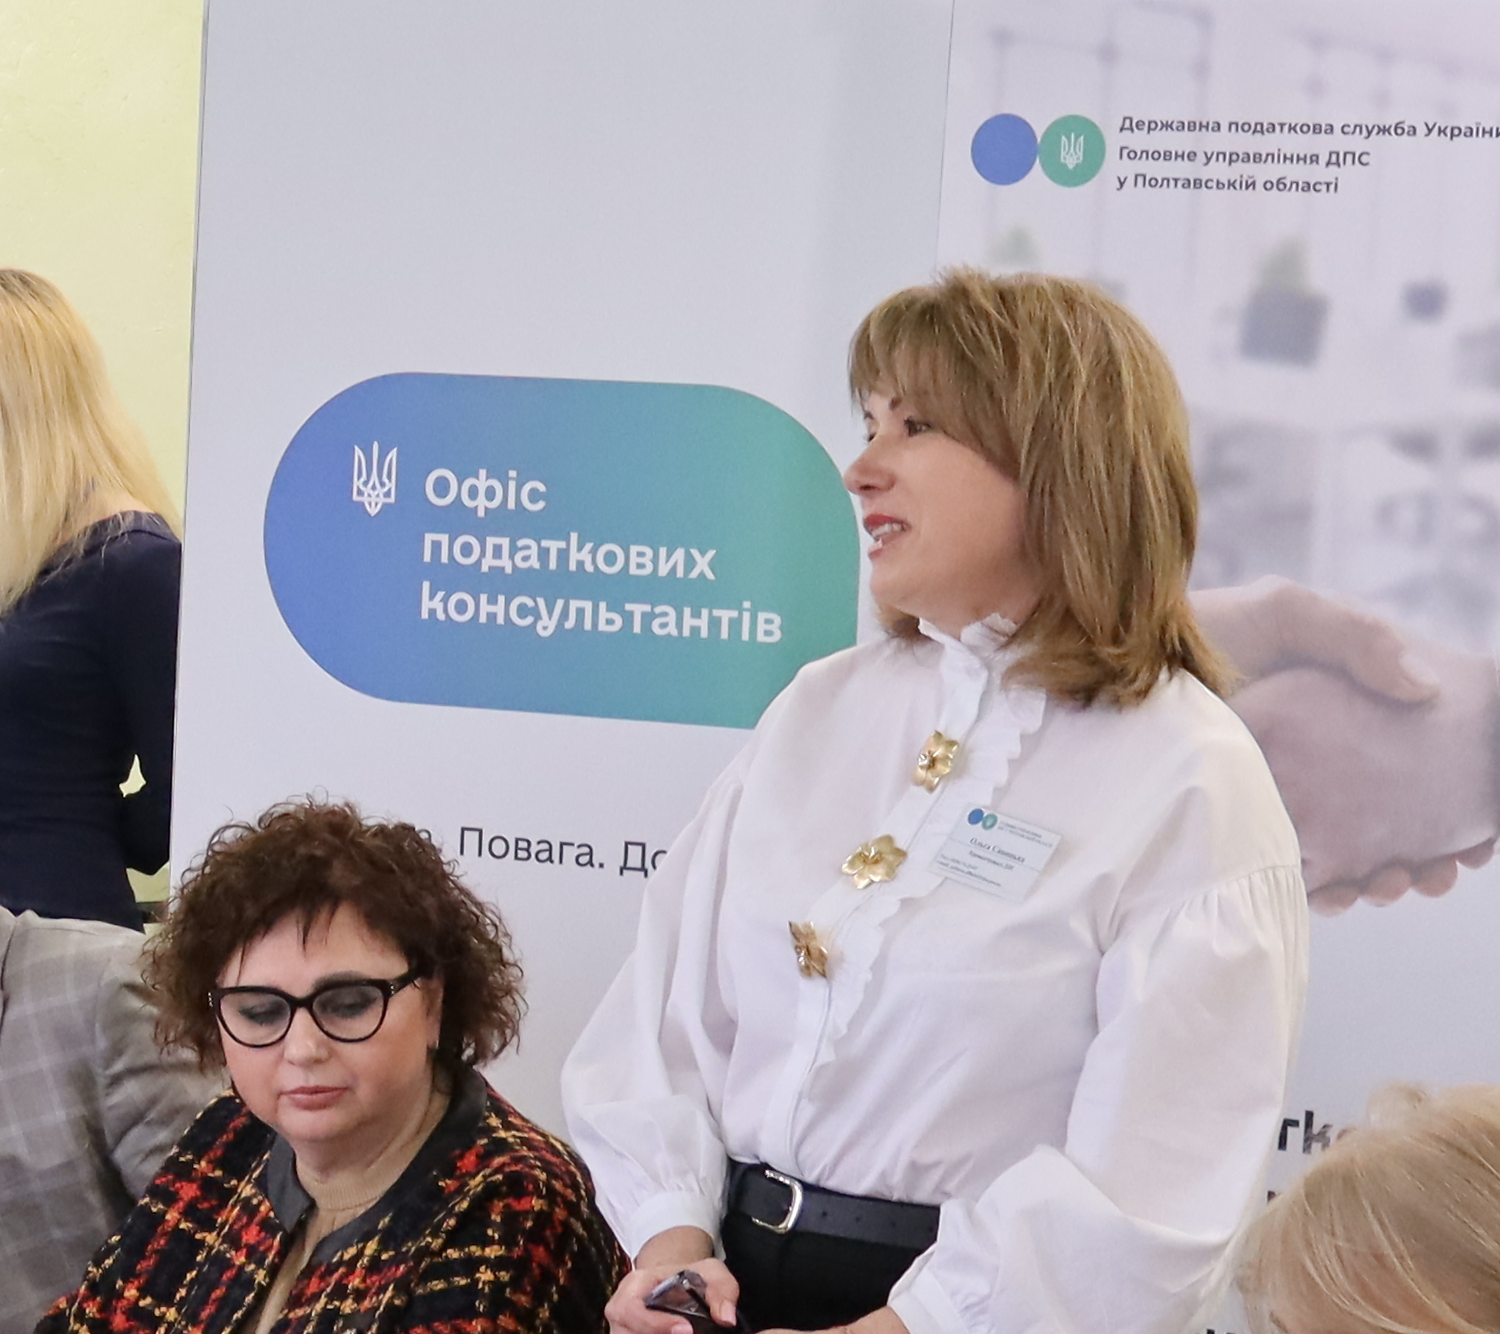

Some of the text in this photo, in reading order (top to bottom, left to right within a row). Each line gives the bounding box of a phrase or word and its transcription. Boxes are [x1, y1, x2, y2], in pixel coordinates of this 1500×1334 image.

[1119, 116, 1221, 135] Державна
[1228, 119, 1334, 137] податкова
[1340, 122, 1417, 139] служба
[1118, 146, 1370, 168] Головне управління ДПС
[1116, 173, 1339, 194] у Полтавській області
[424, 468, 547, 518] Офіс
[422, 532, 717, 581] податкових
[420, 580, 783, 644] консультантів
[459, 826, 604, 869] Повага.
